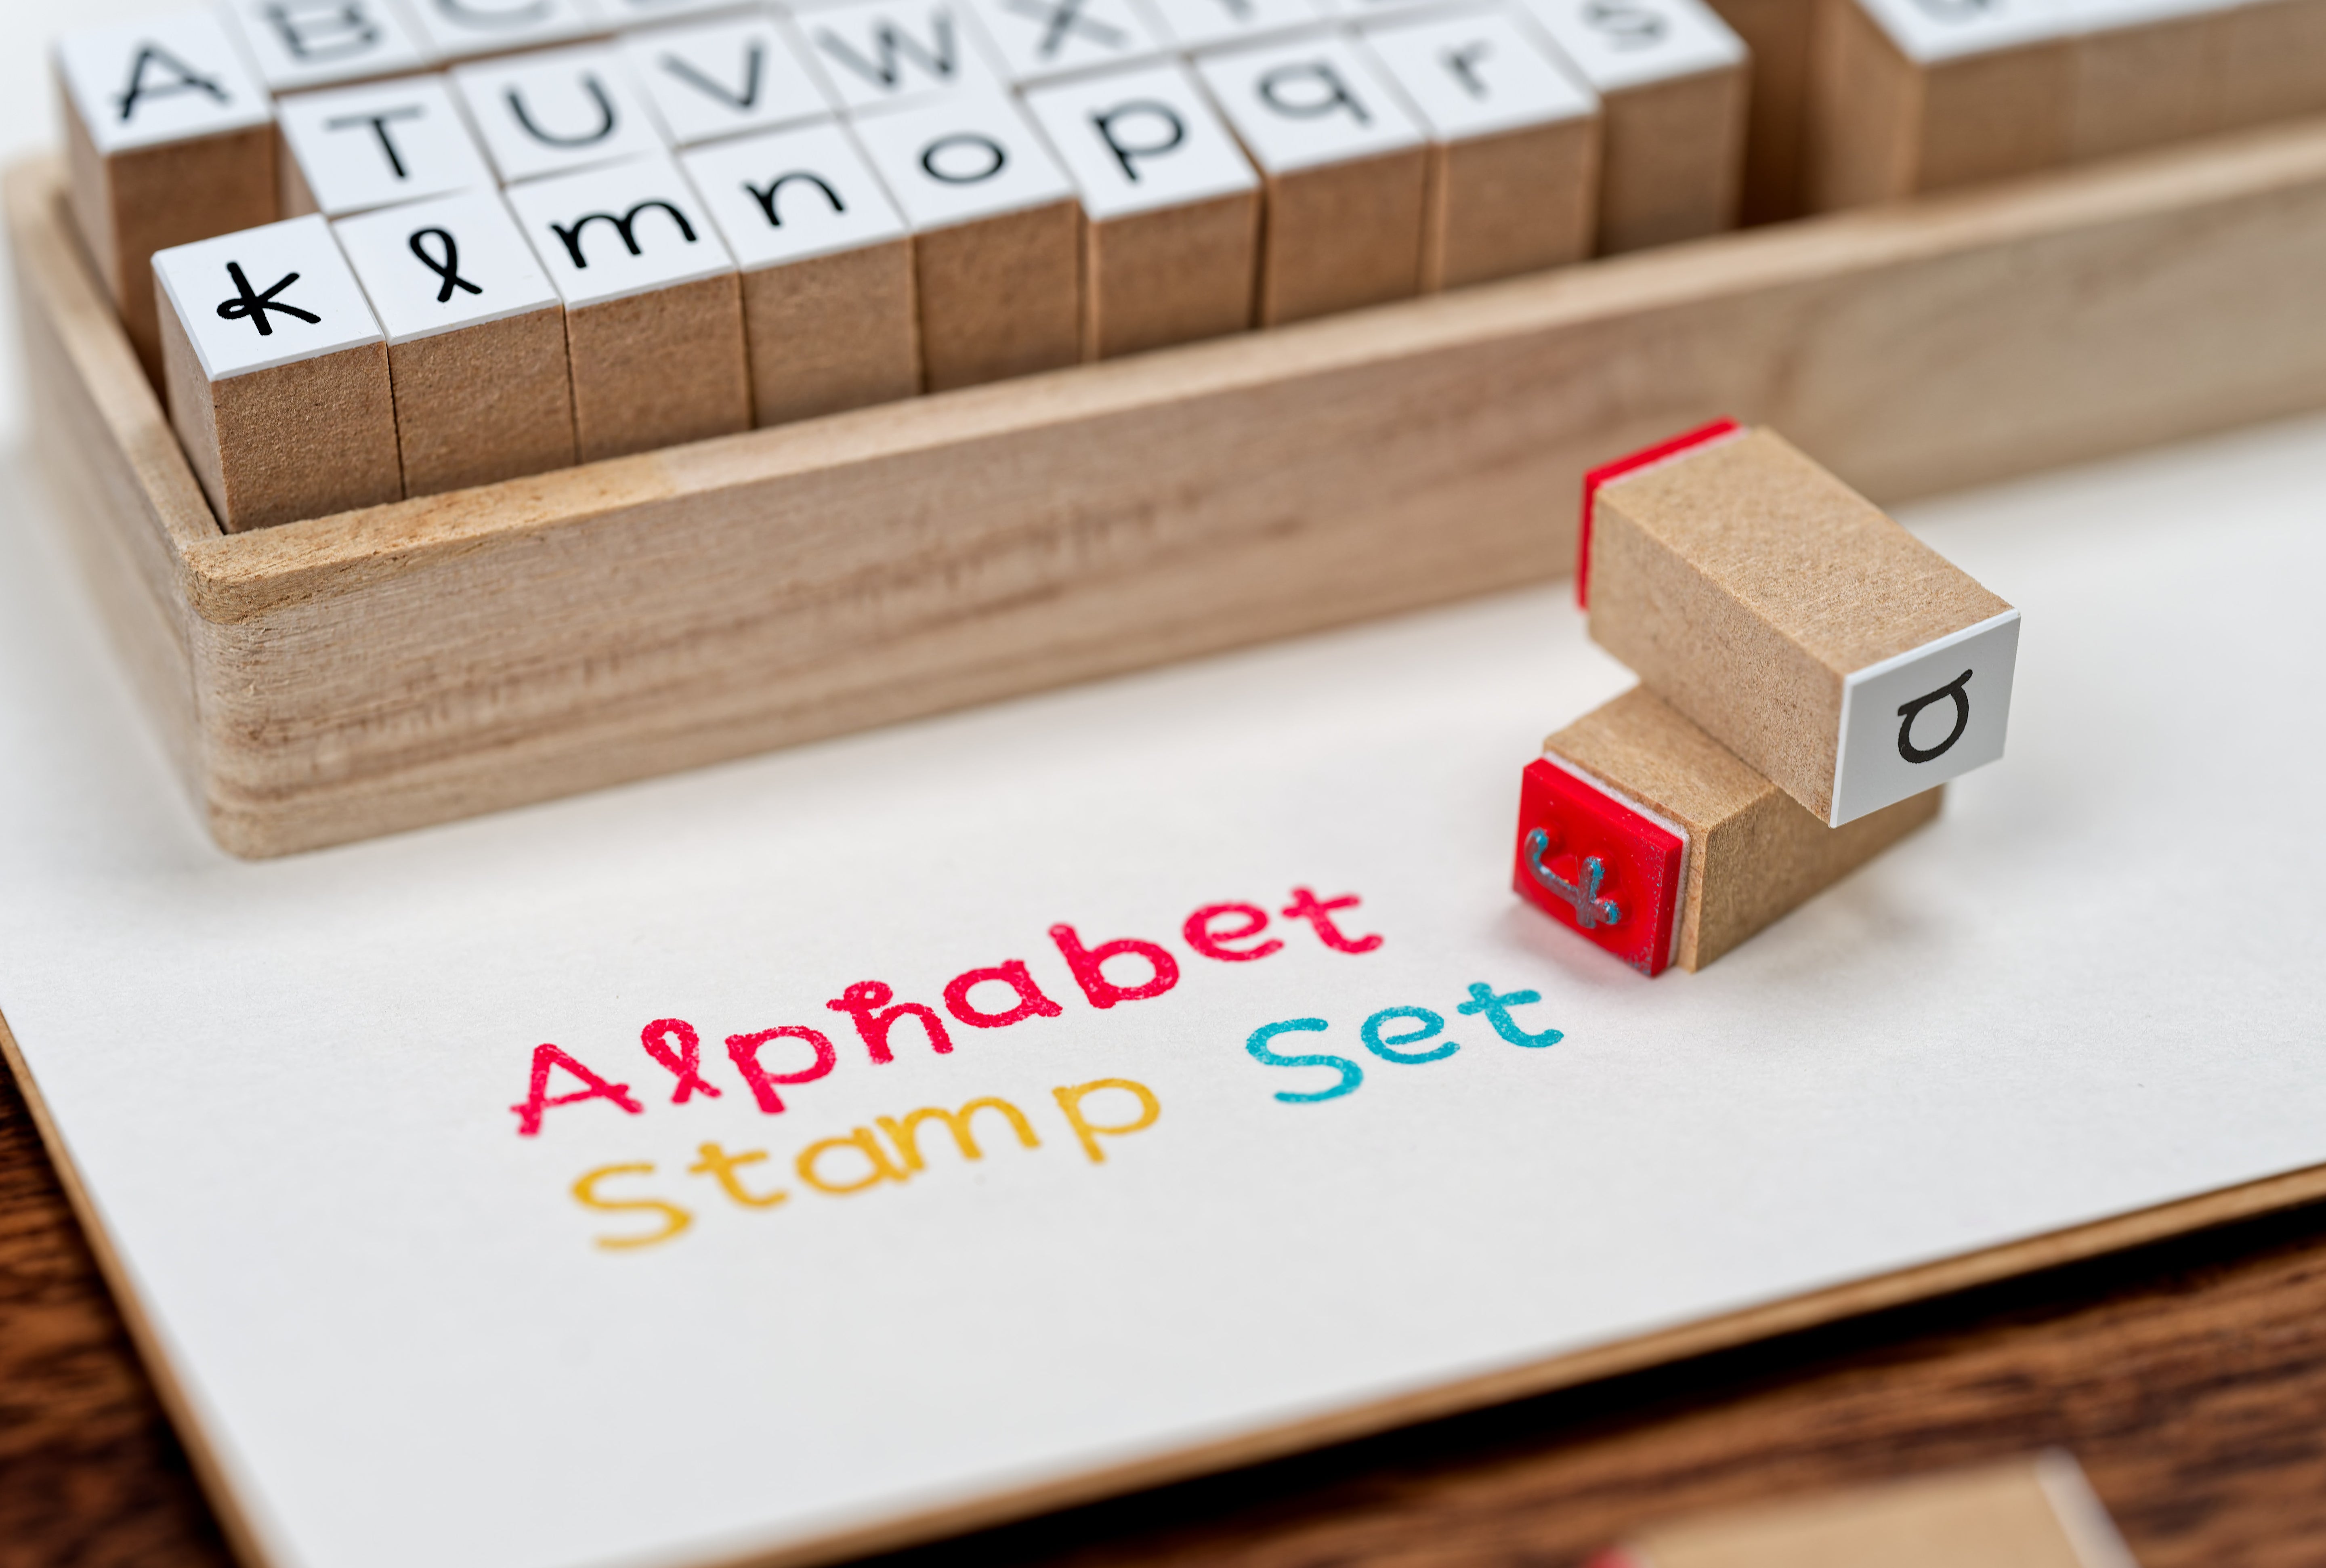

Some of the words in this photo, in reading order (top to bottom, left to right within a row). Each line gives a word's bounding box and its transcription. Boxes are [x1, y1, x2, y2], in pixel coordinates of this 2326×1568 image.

[112, 40, 231, 122] A
[323, 103, 424, 181] T
[503, 73, 620, 148] U
[658, 40, 764, 110] V
[815, 10, 956, 90] W
[549, 200, 698, 270] m
[742, 172, 846, 229] n
[1088, 99, 1189, 184] p
[1255, 60, 1371, 125] q
[1437, 40, 1493, 101] r
[509, 886, 1384, 1138] Alphabet
[569, 1076, 1161, 1252] Stamp
[1245, 981, 1565, 1104] Set
